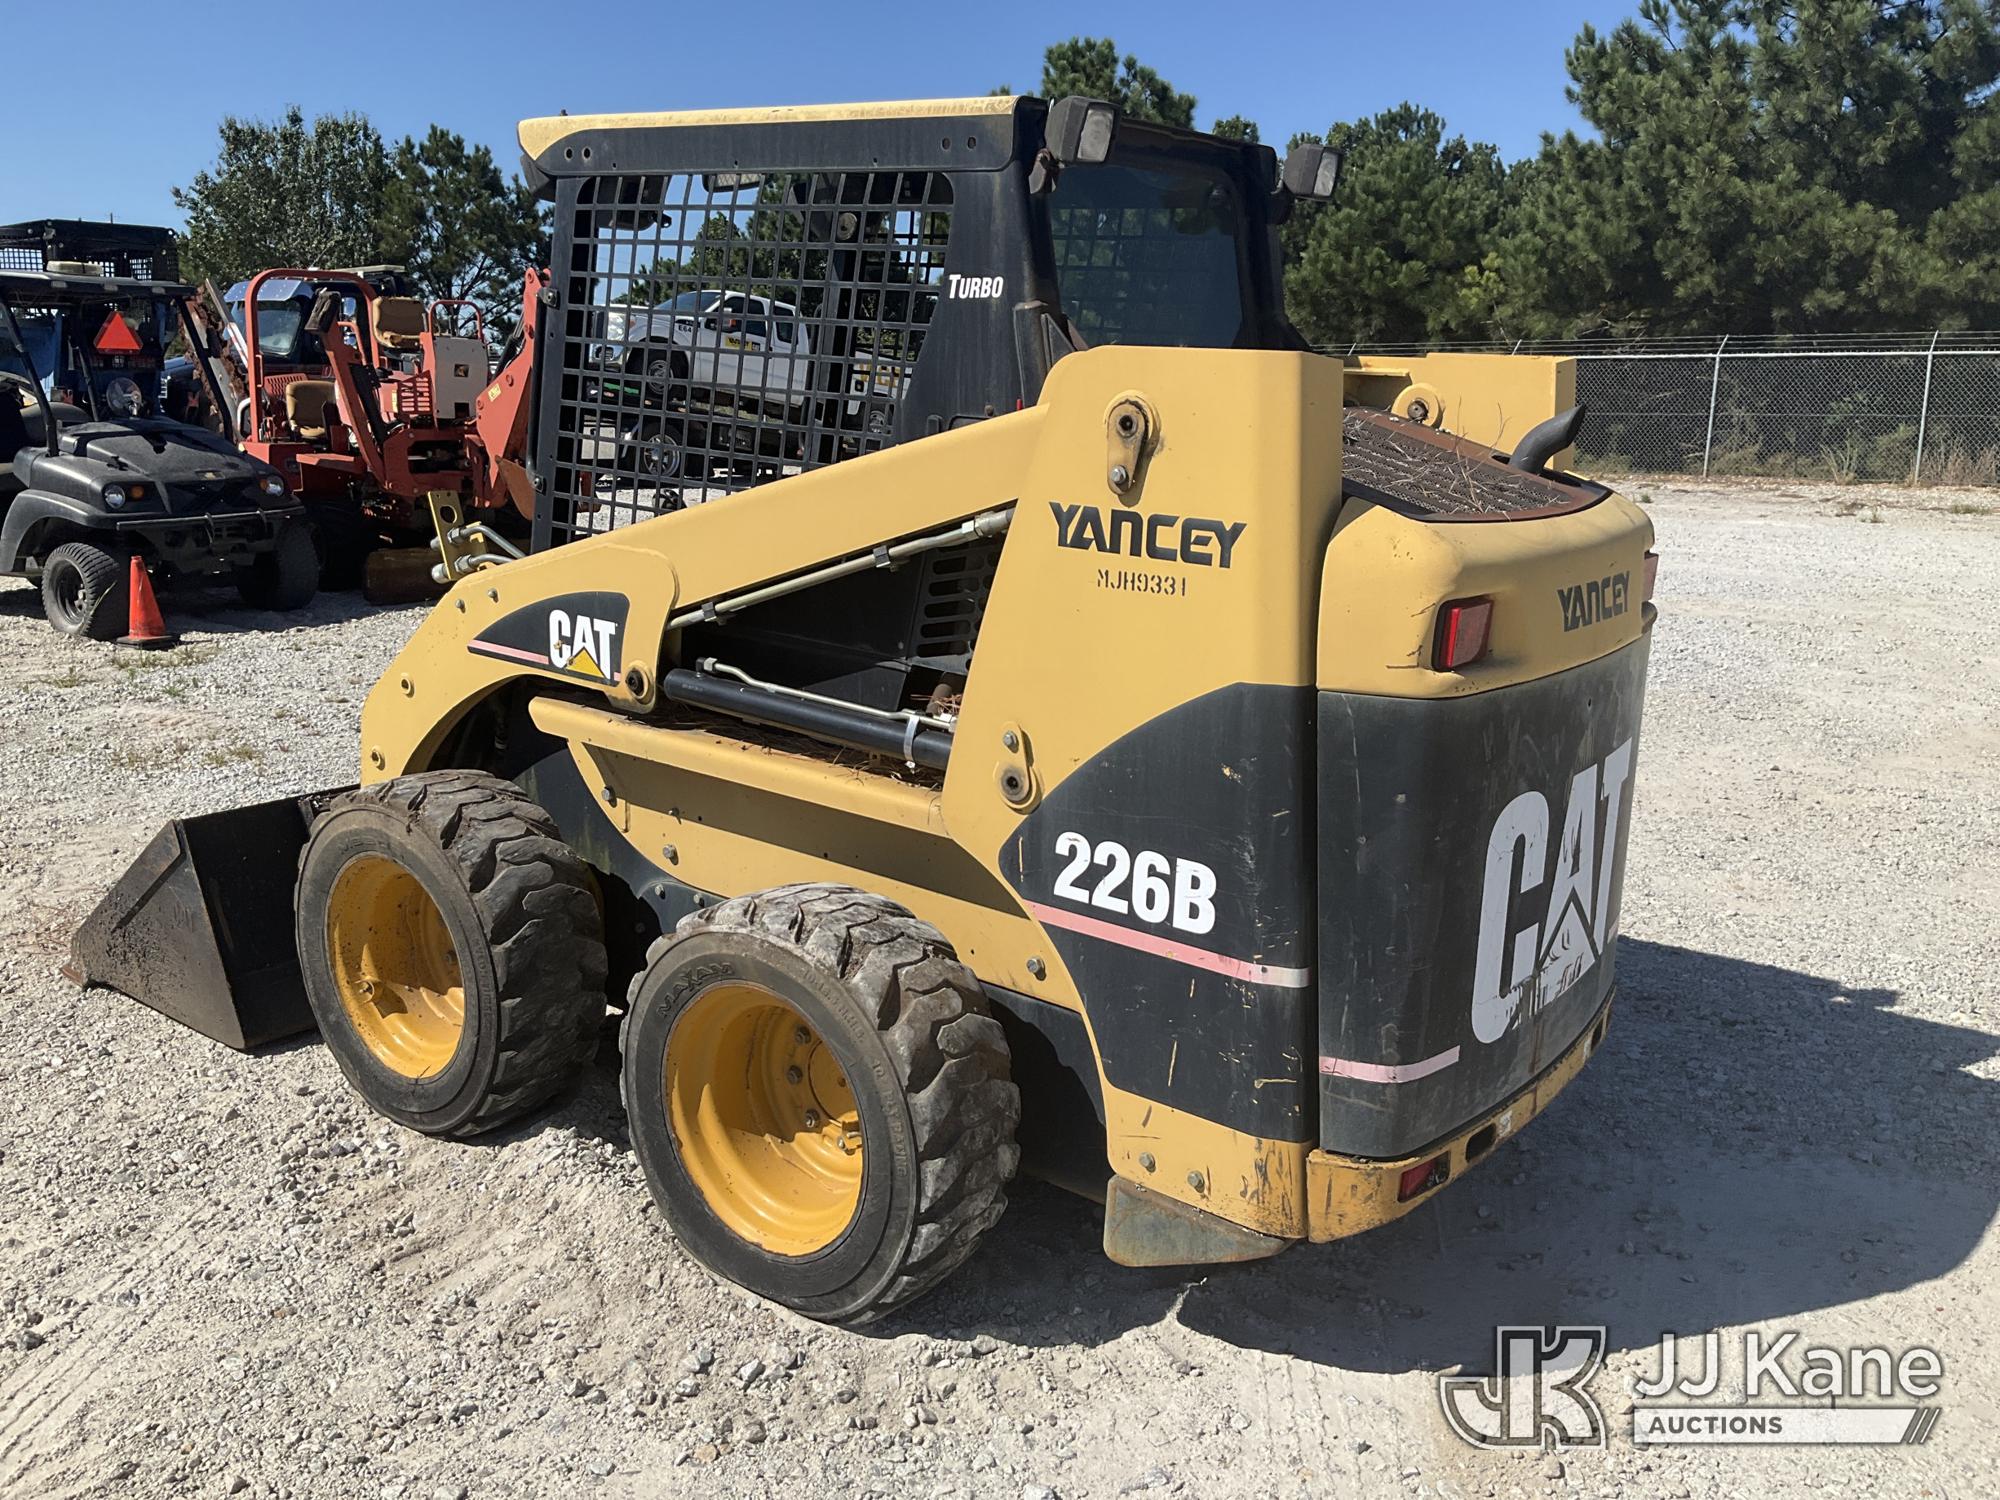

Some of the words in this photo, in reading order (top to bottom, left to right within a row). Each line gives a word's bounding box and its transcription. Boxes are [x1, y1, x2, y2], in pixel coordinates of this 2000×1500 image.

[1049, 502, 1247, 568] YANCEY
[1097, 569, 1187, 597] MJH9331
[1558, 571, 1630, 632] YANCEY
[549, 609, 616, 680] CAT
[1053, 831, 1217, 935] 226B
[1471, 740, 1632, 1044] CAT
